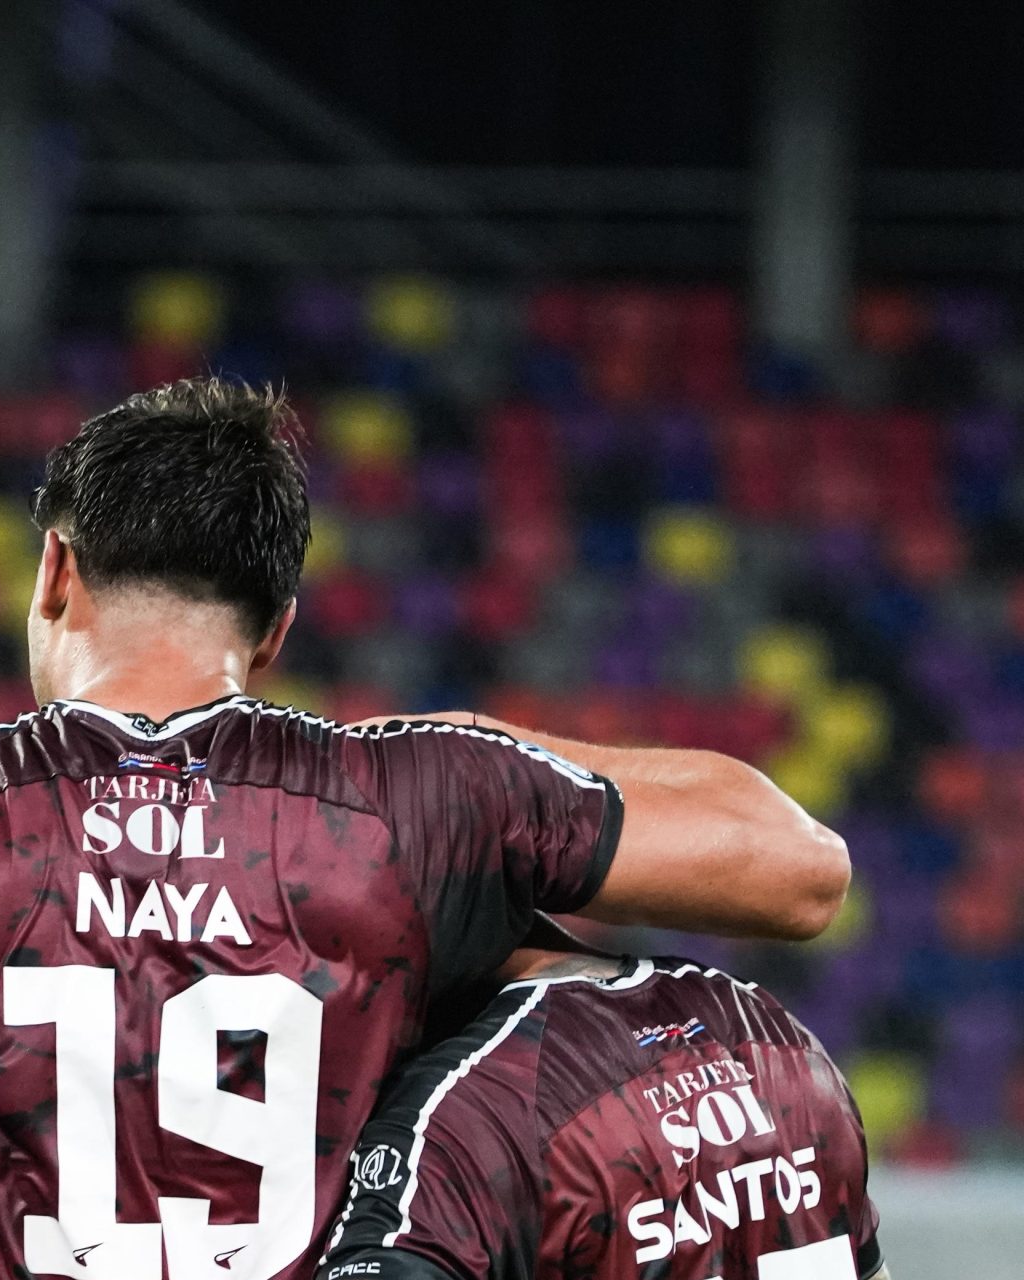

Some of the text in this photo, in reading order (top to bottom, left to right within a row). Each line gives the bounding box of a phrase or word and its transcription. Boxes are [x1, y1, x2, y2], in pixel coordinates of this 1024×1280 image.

[82, 801, 225, 859] SOL
[76, 871, 253, 945] NAYA
[660, 1084, 776, 1168] SOL
[627, 1147, 821, 1264] SANTOS
